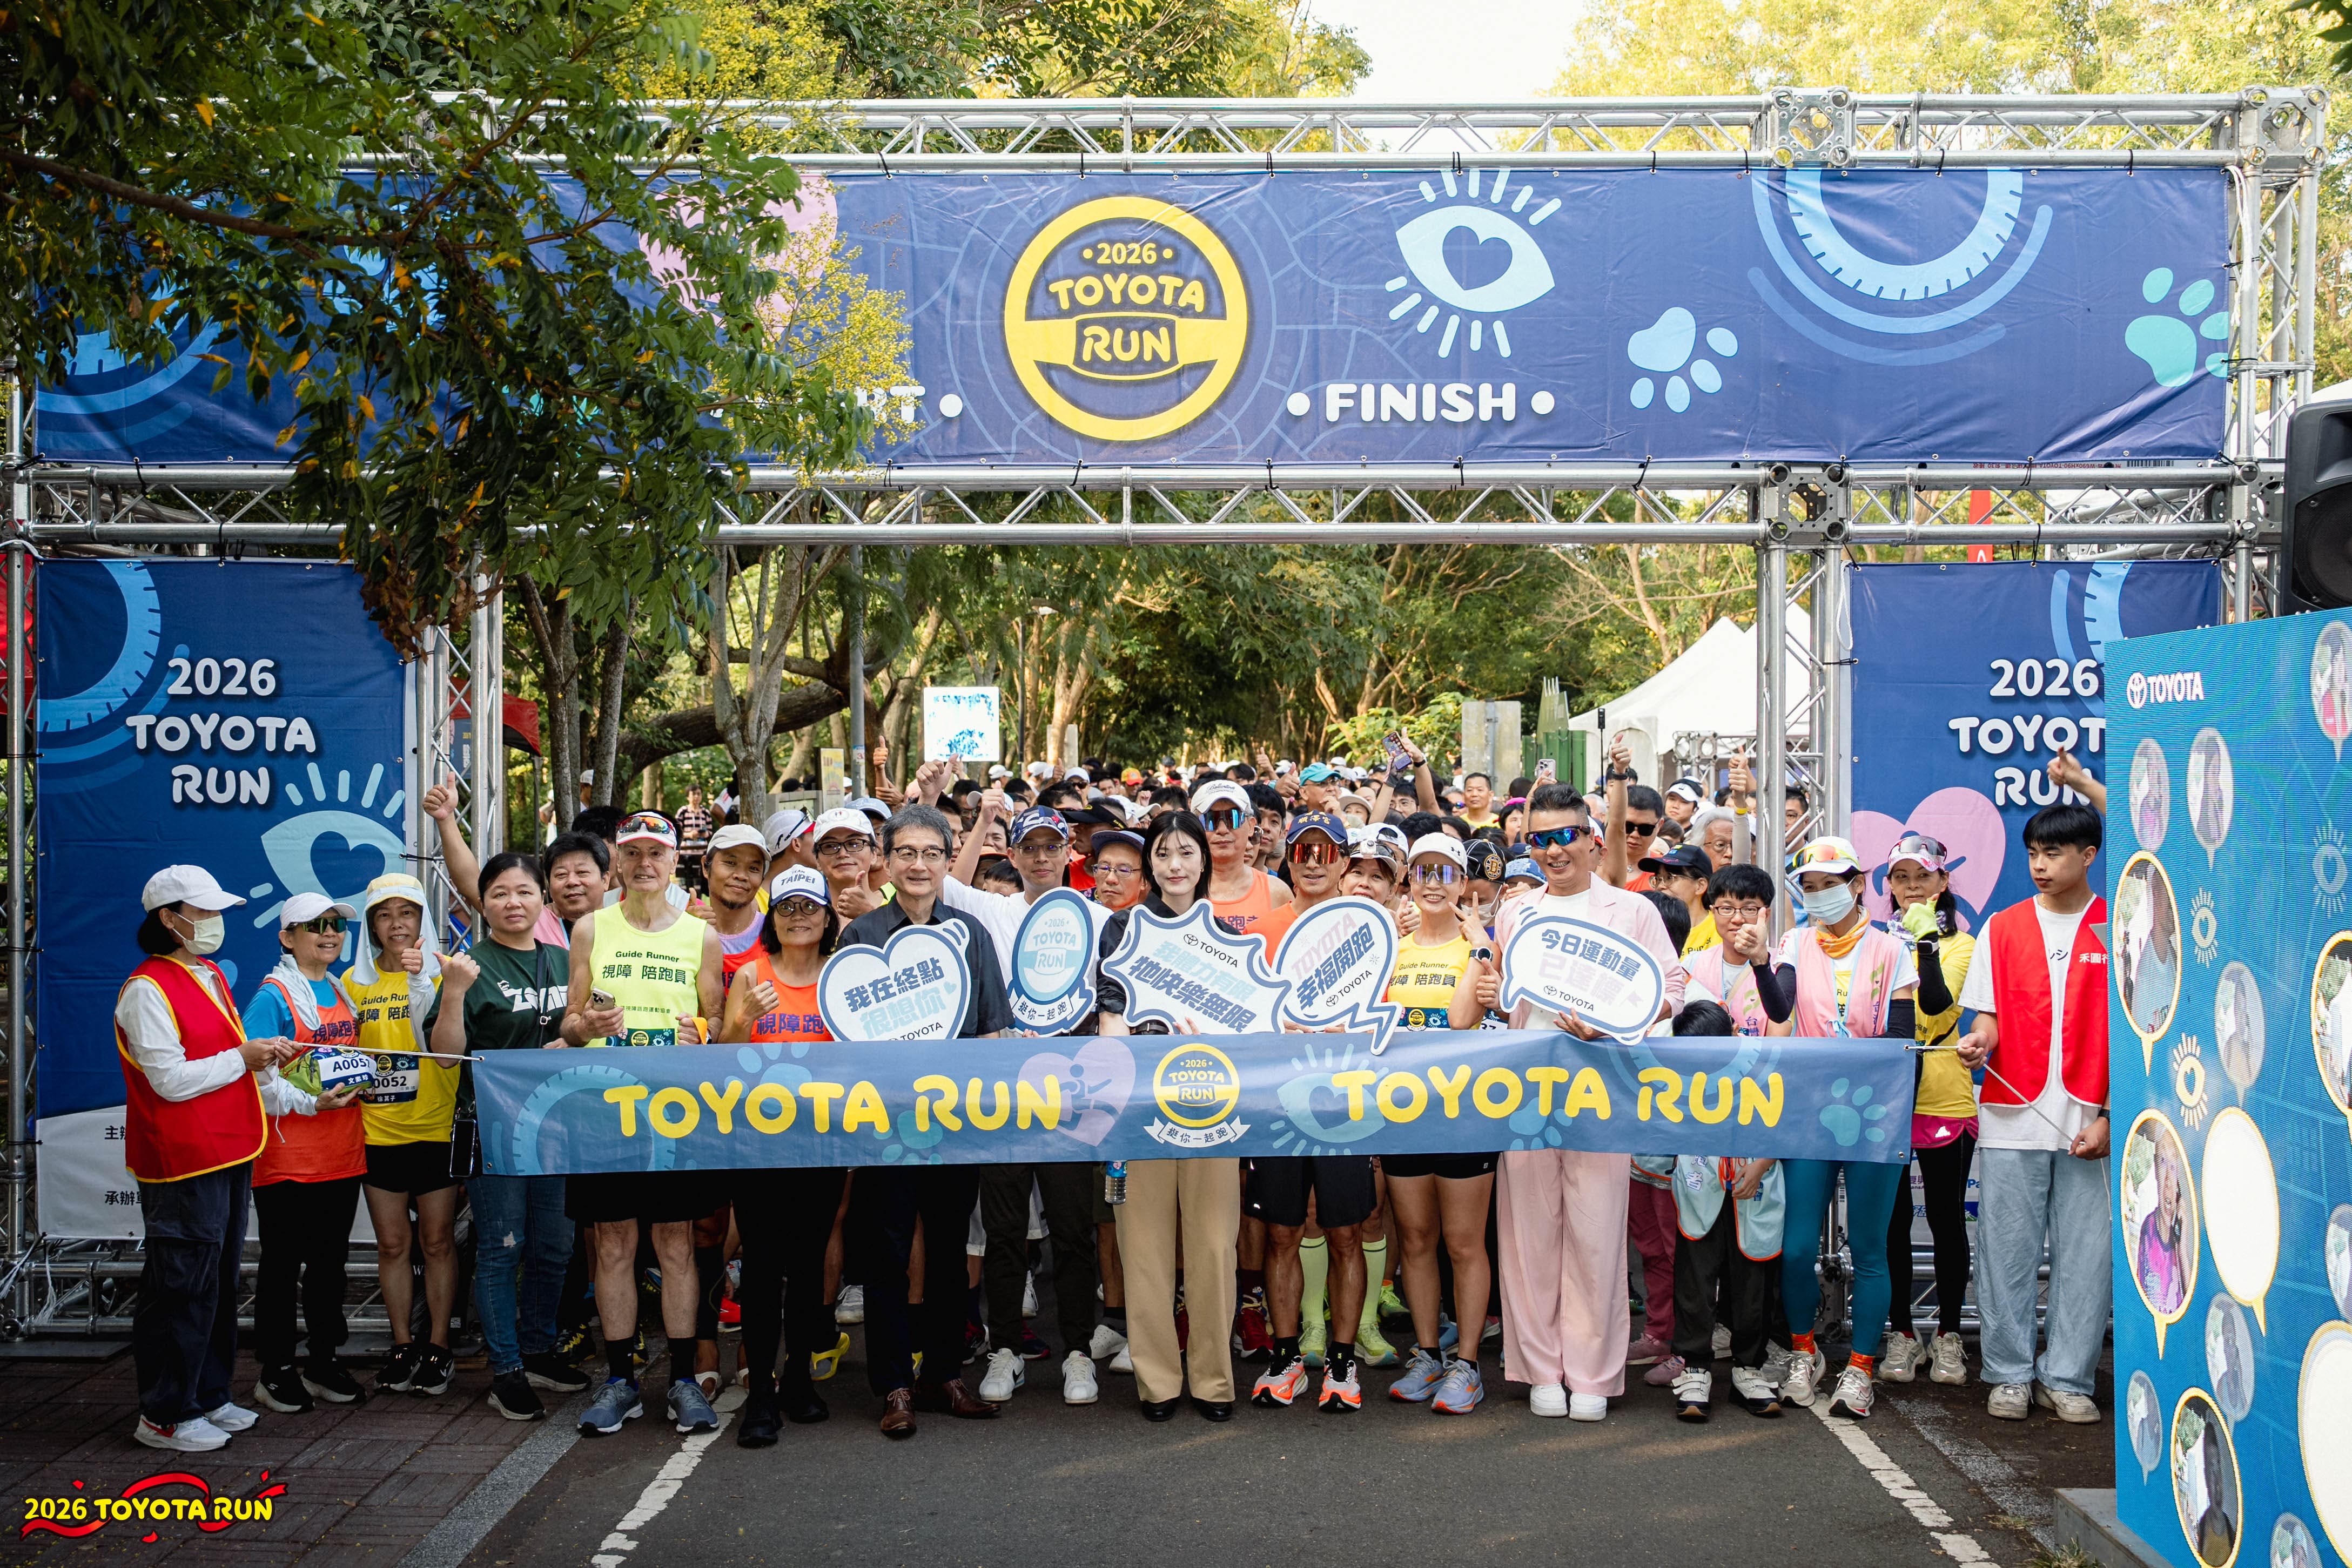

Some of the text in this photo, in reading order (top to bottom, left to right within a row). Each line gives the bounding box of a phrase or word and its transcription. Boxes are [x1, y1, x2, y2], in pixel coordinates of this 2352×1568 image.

[1098, 243, 1157, 264] 2026
[1049, 275, 1205, 314] TOYOTA
[1082, 326, 1172, 362] RUN
[1326, 382, 1516, 422] FINISH
[167, 658, 275, 696] 2026
[1990, 659, 2099, 696] 2026
[2147, 672, 2204, 703] TOYOTA
[126, 713, 316, 752] TOYOTA
[1948, 715, 2105, 753] TOYOT
[172, 764, 270, 805] RUN
[781, 874, 816, 886] TAIPEI
[1048, 918, 1065, 927] 2026
[1032, 931, 1077, 947] TOYOTA
[1292, 912, 1357, 981] TOYOTA
[646, 951, 680, 963] Runner
[1038, 953, 1064, 968] RUN
[1200, 941, 1238, 968] TOYOTA
[1296, 922, 1375, 1011] 幸福開跑
[1399, 962, 1418, 971] Guide
[1541, 928, 1642, 982] 今日運動量
[602, 964, 687, 985] 視障 陪跑員
[1152, 940, 1257, 1002] 我體力有限
[1338, 970, 1373, 997] TOYOTA
[1415, 973, 1456, 988] 陪跑員
[844, 957, 945, 1013] 我在終點
[1127, 955, 1257, 1033] 牠快樂無限
[361, 995, 388, 1006] Guide
[388, 1005, 411, 1021] 陪跑
[859, 986, 946, 1040] 很想你
[1559, 991, 1594, 1012] TOYOTA
[756, 1013, 825, 1035] 視障跑
[900, 1022, 943, 1041] TOYOTA
[1168, 1069, 1225, 1084] TOYOTA
[1185, 1059, 1207, 1068] 2026
[374, 1075, 407, 1089] 0052
[1181, 1087, 1213, 1100] RUN
[603, 1074, 1061, 1138] TOYOTA RUN
[1332, 1065, 1784, 1127] TOYOTA RUN
[1166, 1127, 1228, 1143] 挺你一起跑
